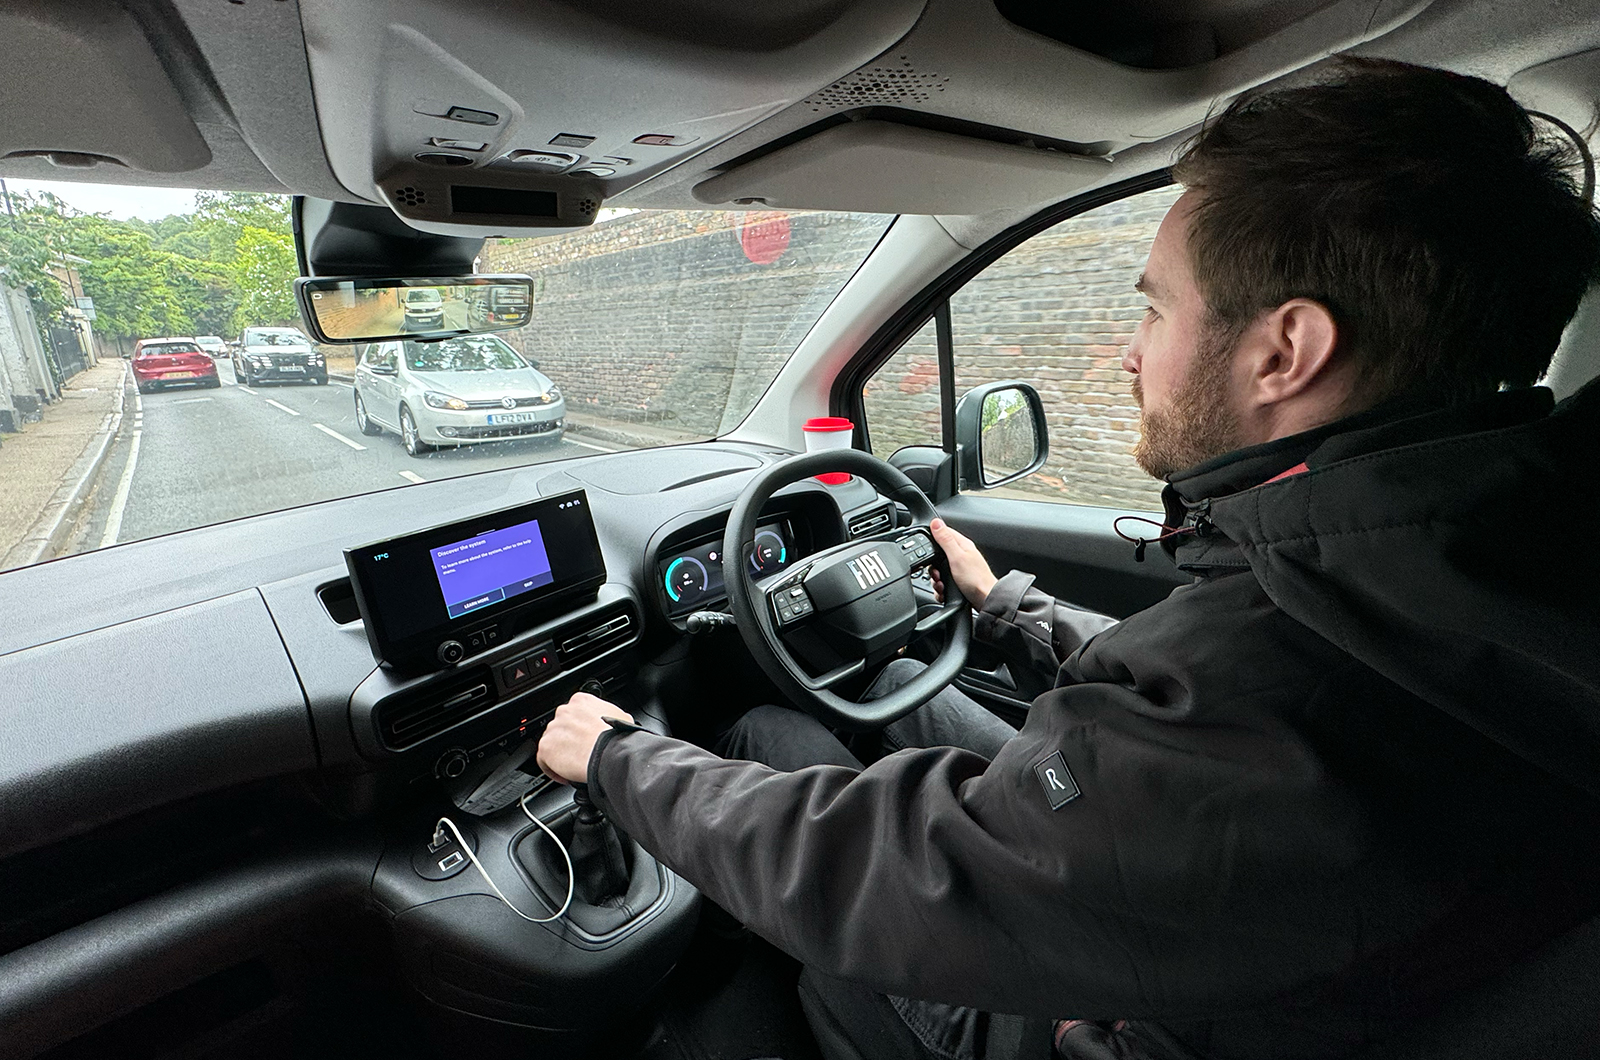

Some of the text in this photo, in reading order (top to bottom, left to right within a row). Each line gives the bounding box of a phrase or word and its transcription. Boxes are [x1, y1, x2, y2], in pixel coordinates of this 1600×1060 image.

[437, 546, 460, 557] Discover
[469, 540, 486, 549] system
[846, 550, 891, 590] FIAT
